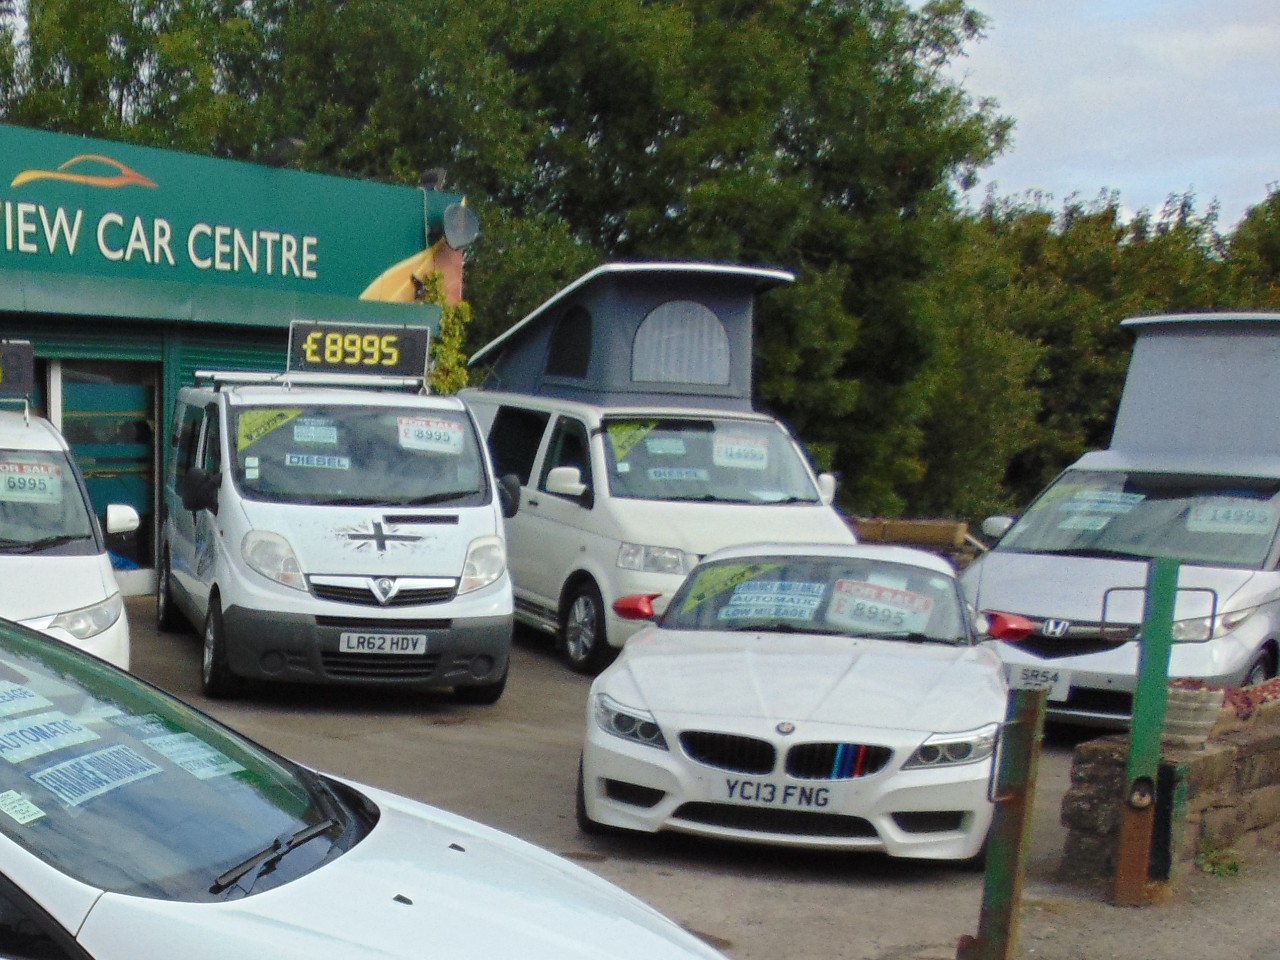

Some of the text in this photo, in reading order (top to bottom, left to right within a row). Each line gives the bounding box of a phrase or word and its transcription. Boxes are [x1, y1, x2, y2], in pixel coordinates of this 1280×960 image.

[96, 212, 176, 266] CAR
[186, 222, 318, 280] CENTRE
[302, 332, 400, 367] £8995
[23, 464, 56, 474] SALE
[289, 455, 349, 468] DIESEL
[6, 475, 48, 491] 6995
[346, 634, 420, 651] LR62 HDV
[725, 778, 830, 807] YC13 FNG
